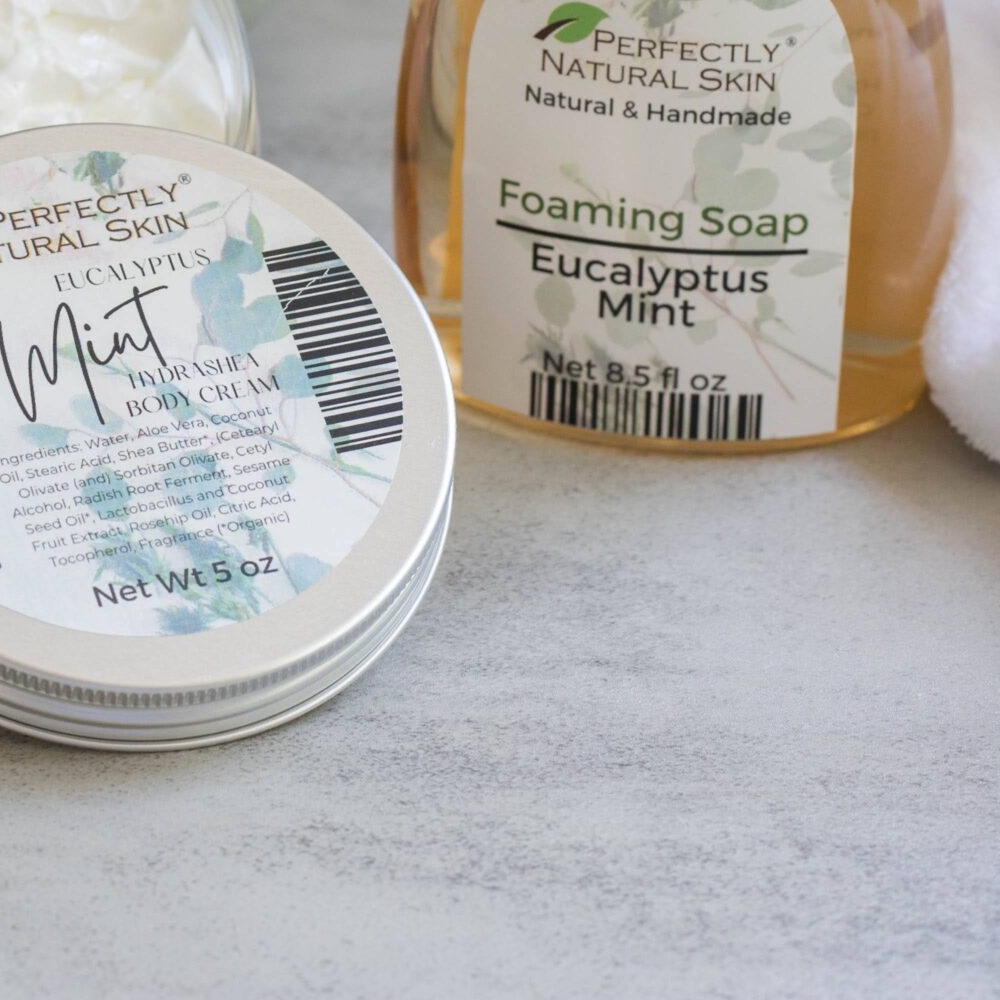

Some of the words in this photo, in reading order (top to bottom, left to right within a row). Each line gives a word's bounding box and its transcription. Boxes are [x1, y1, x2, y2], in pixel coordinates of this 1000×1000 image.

[540, 49, 689, 91] NATURAL
[699, 68, 777, 92] SKIN
[524, 84, 614, 116] Natural
[622, 101, 639, 120] &
[646, 103, 792, 127] Handmade
[106, 211, 190, 242] SKIN
[500, 178, 684, 242] Foaming
[700, 206, 809, 244] Soap
[54, 247, 211, 292] EUCALYPTUS
[531, 243, 770, 299] Eucalyptus
[597, 291, 696, 328] Mint
[128, 352, 260, 389] HYDRASHEA
[543, 350, 597, 381] Net
[606, 362, 650, 388] 8.5
[661, 366, 679, 390] fl
[691, 374, 727, 392] oz
[126, 390, 191, 418] BODY
[199, 374, 280, 403] CREAM
[84, 432, 134, 450] Water,
[137, 425, 169, 439] Aloe
[174, 417, 208, 432] Vera,
[210, 406, 272, 426] Coconut
[0, 470, 23, 484] Oil,
[26, 459, 75, 480] Stearic
[80, 453, 115, 470] Acid,
[119, 445, 154, 462] Shea
[216, 421, 279, 445] (Cetearyl
[18, 482, 69, 500] Olivate
[73, 472, 111, 491] (and)
[115, 460, 175, 480] Sorbitan
[180, 451, 233, 468] Olivate,
[236, 441, 272, 458] Cetyl
[12, 500, 71, 519] Alcohol,
[74, 487, 123, 507] Radish
[126, 481, 162, 497] Root
[164, 470, 231, 488] Ferment,
[234, 456, 290, 475] Sesame
[24, 519, 62, 535] Seed
[98, 495, 193, 520] Lactobacillus
[197, 485, 224, 500] and
[227, 474, 290, 495] Coconut
[31, 537, 67, 552] Fruit
[129, 514, 189, 534] Rosehip
[191, 506, 216, 521] Oil,
[218, 496, 257, 515] Citric
[260, 490, 296, 506] Acid,
[139, 529, 213, 551] Fragrance
[93, 581, 152, 607] Net
[156, 568, 207, 594] Wt
[213, 561, 232, 583] 5
[240, 556, 279, 578] oz
